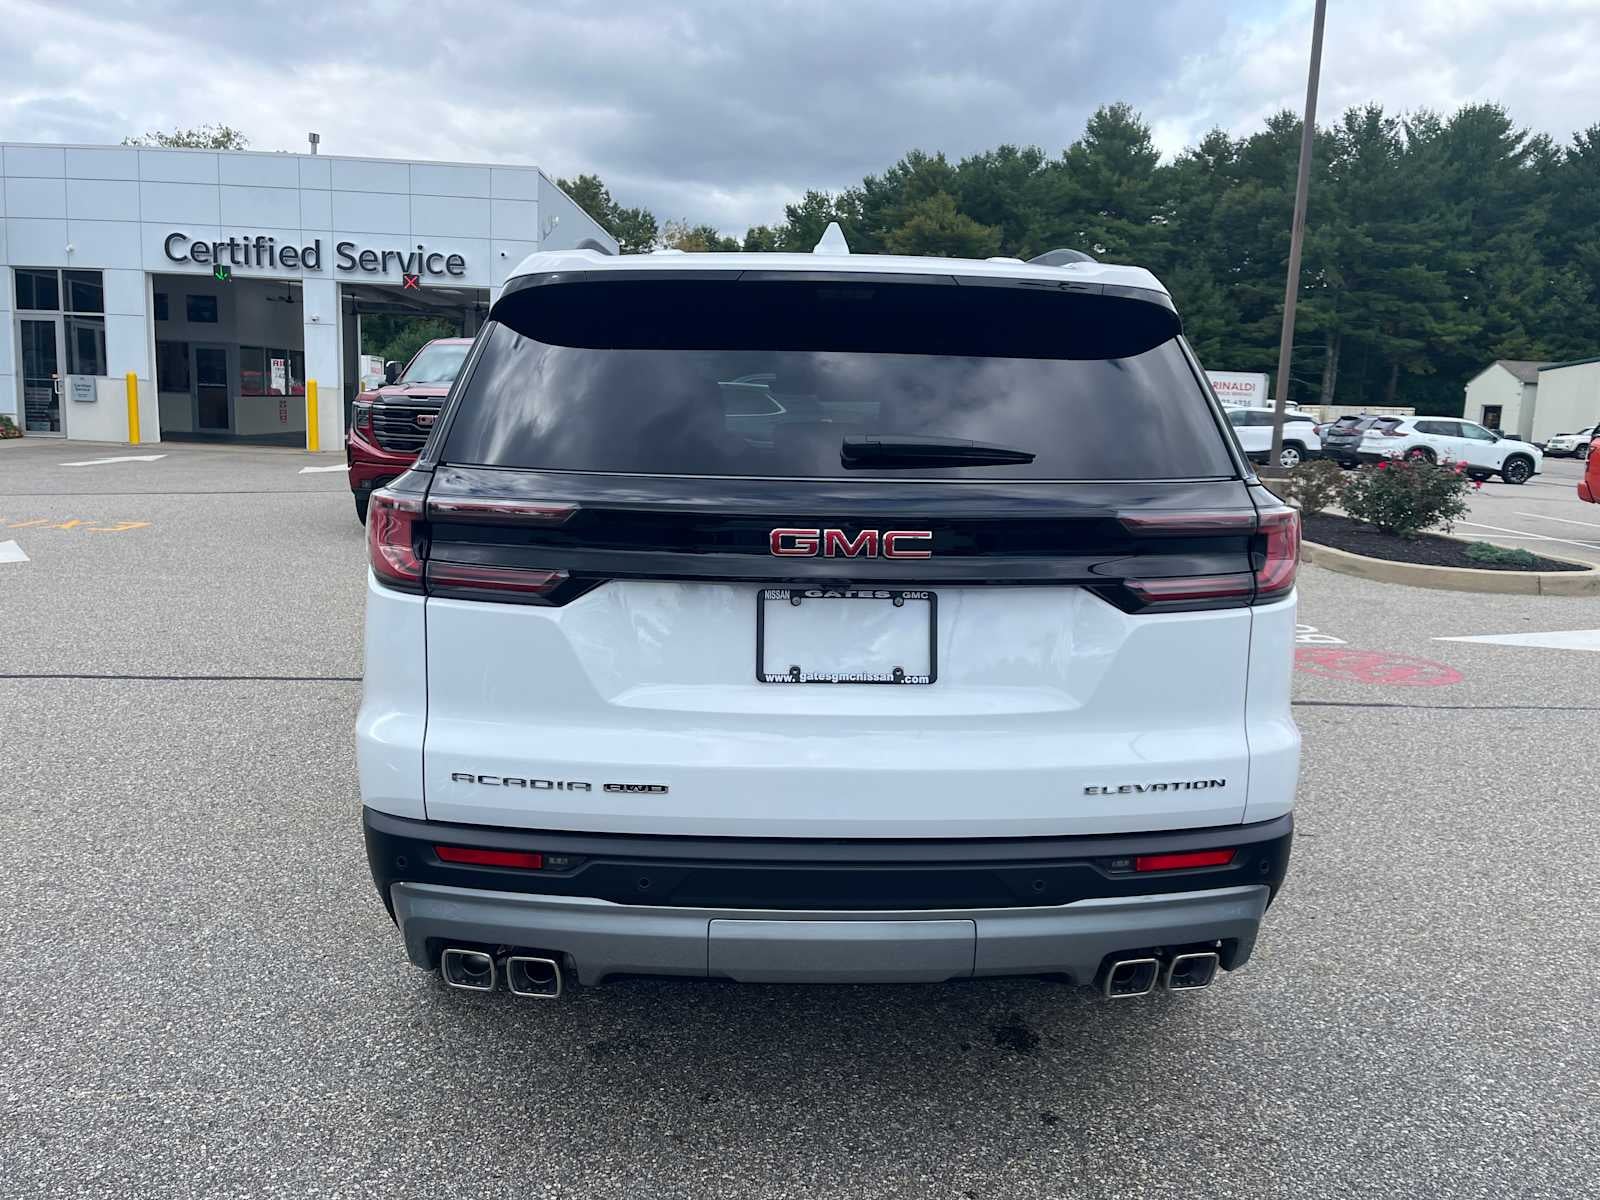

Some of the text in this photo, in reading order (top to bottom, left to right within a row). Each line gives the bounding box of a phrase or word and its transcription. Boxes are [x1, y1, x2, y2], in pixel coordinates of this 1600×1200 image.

[164, 232, 466, 276] Certified Service
[769, 528, 933, 559] GMC
[764, 590, 929, 600] NISSAN GATES GMC
[451, 772, 669, 794] ACADIA AWD
[1084, 779, 1226, 795] ELEVATION
